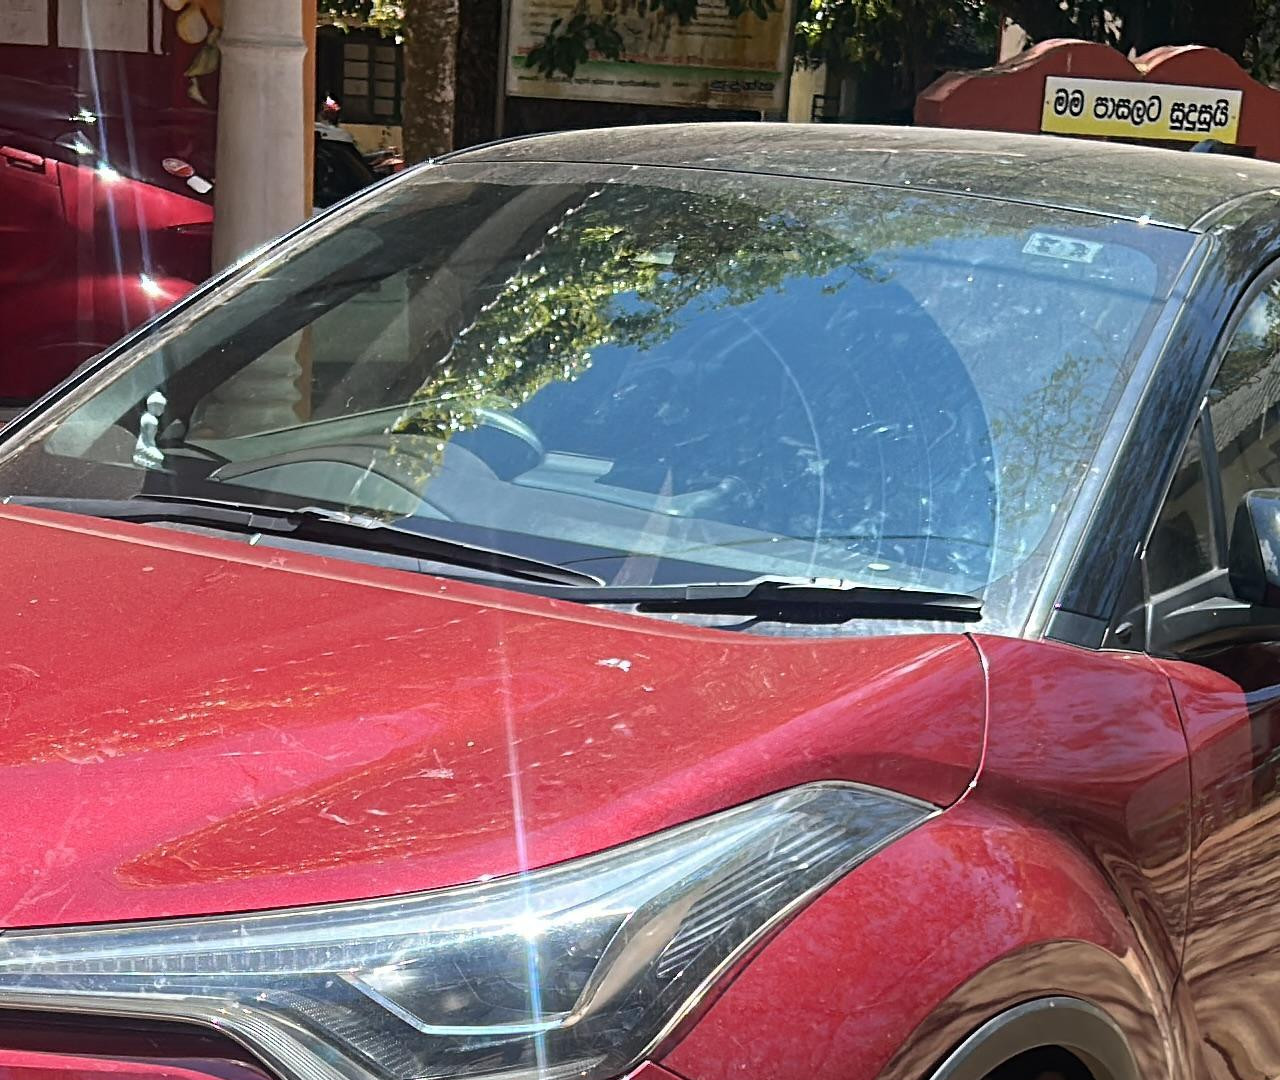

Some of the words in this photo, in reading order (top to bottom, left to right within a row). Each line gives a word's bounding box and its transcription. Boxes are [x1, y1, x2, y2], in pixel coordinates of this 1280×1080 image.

[1053, 88, 1084, 117] මම
[1093, 95, 1162, 126] පාසලට
[1169, 98, 1230, 132] සුදුසුයි
